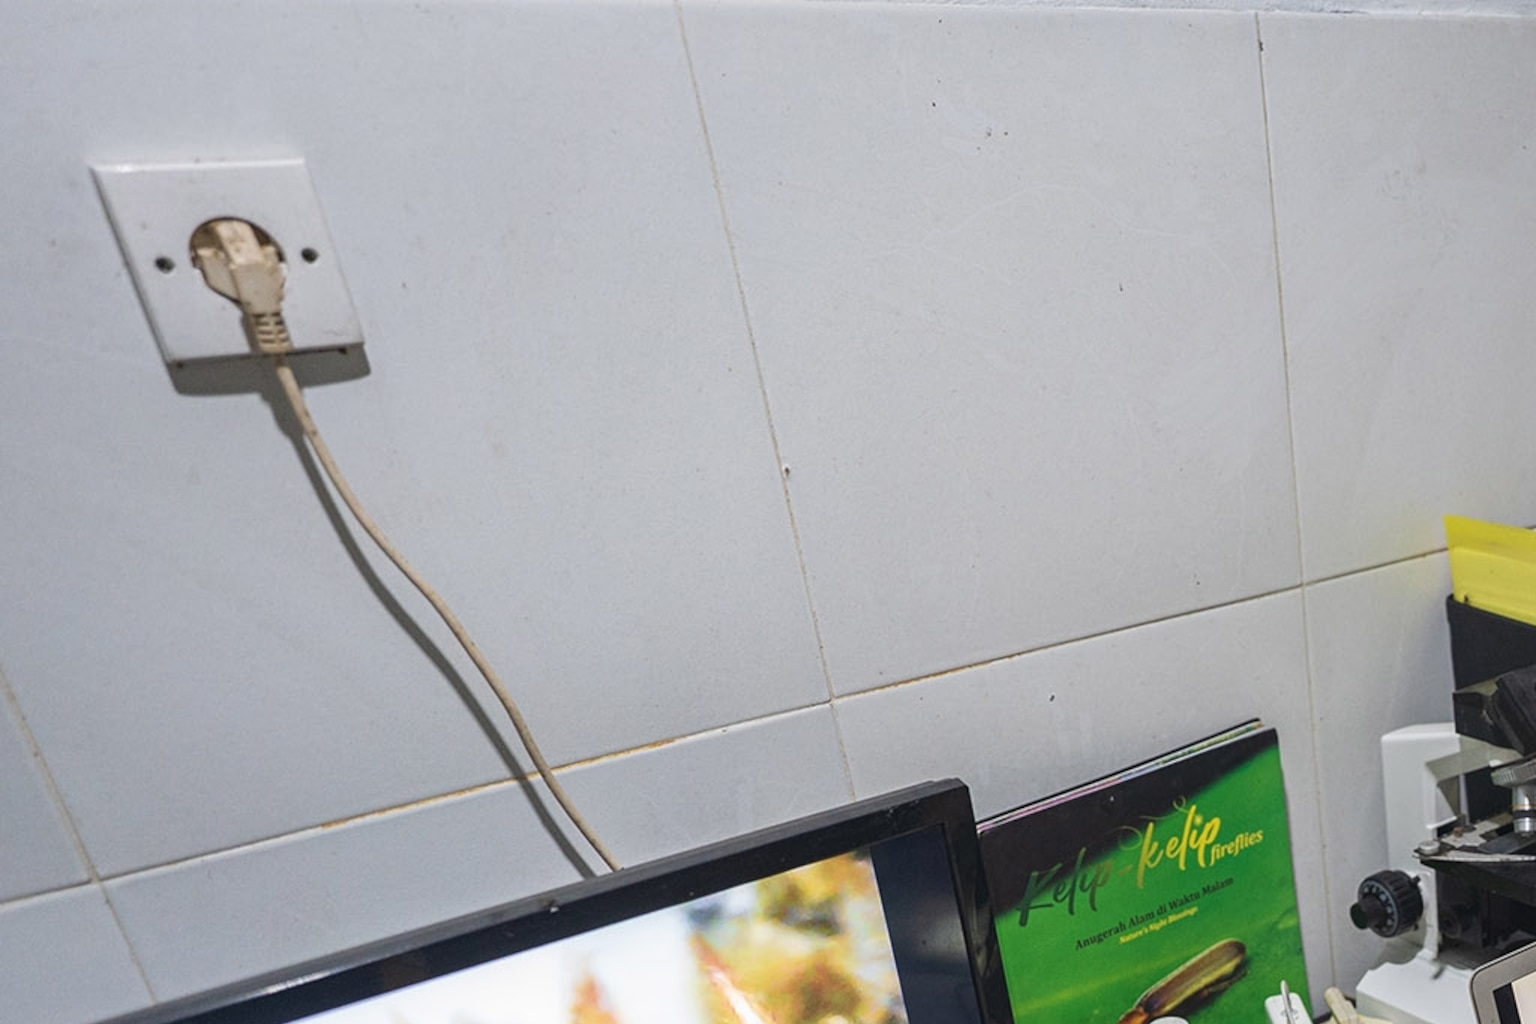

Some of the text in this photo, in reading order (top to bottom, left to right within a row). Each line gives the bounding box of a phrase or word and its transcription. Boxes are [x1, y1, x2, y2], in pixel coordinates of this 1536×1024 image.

[1209, 829, 1264, 867] fireflies
[1075, 876, 1234, 950] Anugerah Alam di Waktu Malam
